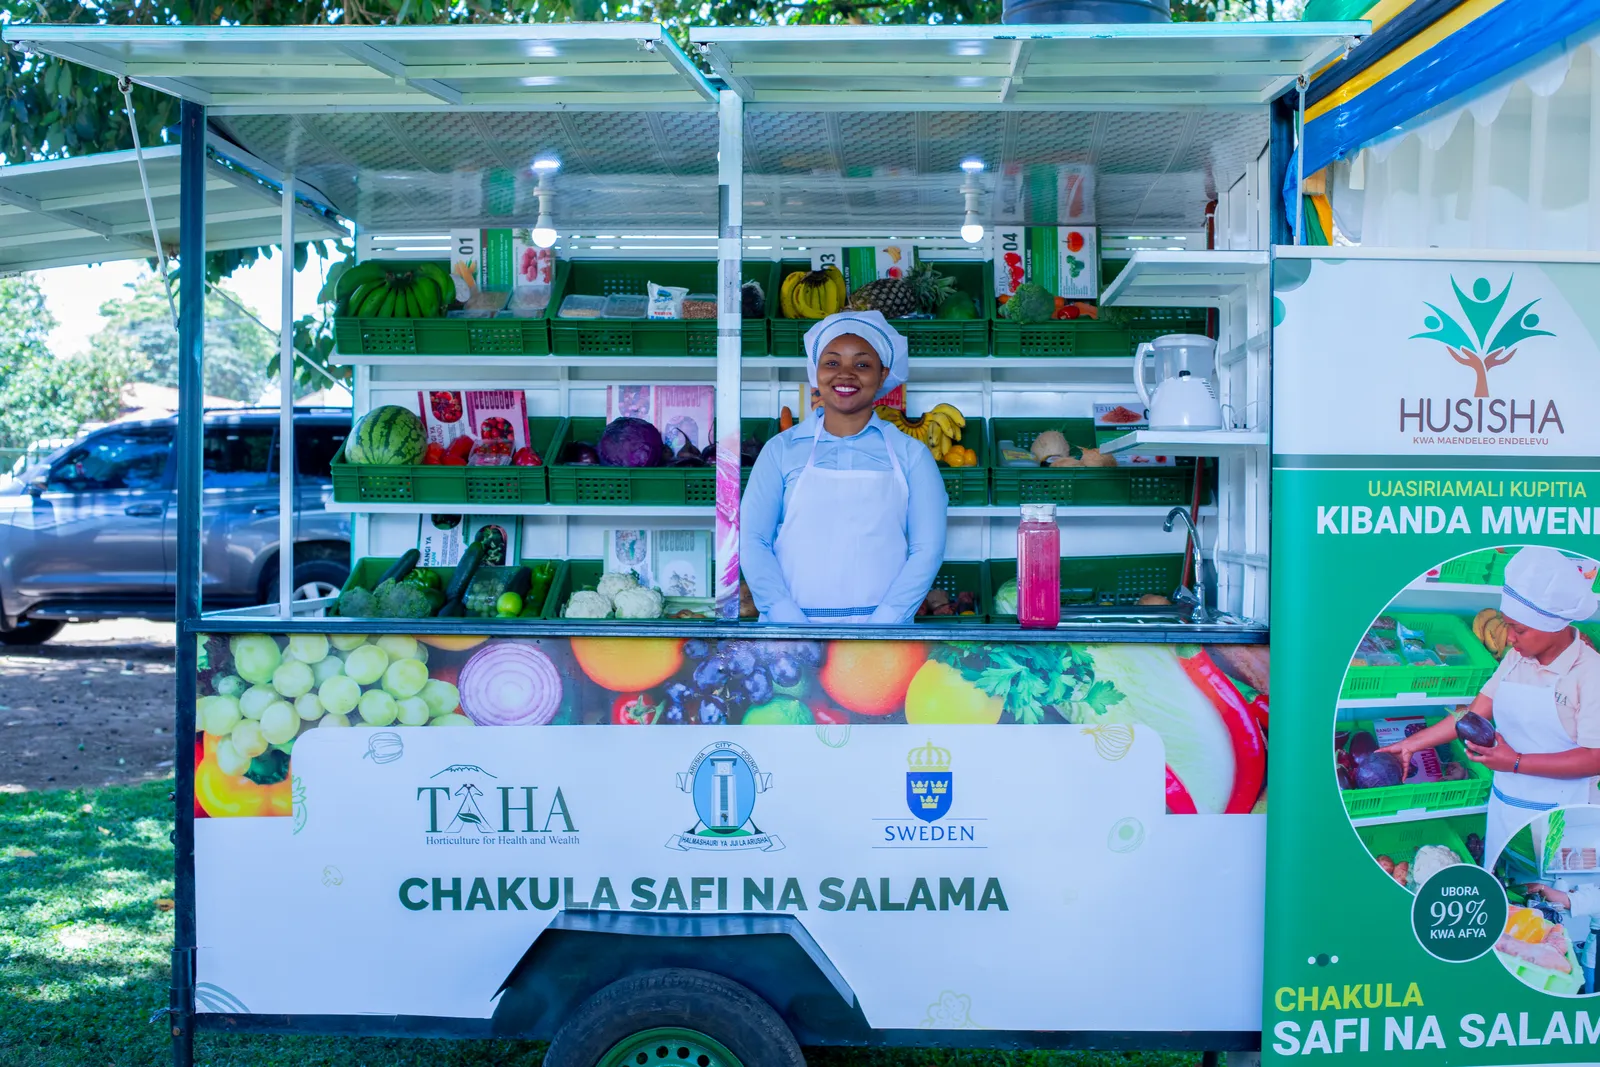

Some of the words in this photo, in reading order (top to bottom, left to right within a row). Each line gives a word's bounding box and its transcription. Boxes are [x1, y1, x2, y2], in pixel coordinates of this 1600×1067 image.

[458, 238, 474, 255] 01
[1002, 232, 1018, 251] 04
[1400, 398, 1565, 434] HUSISHA
[1412, 436, 1435, 445] KWA
[1437, 436, 1496, 446] MAENDELEO
[1498, 437, 1549, 446] ENDELEVU
[1368, 480, 1503, 497] UJASIRIAMALI
[1510, 481, 1587, 498] KUPITIA
[1316, 505, 1471, 535] KIBANDA
[689, 752, 706, 776] ARUSHA
[426, 836, 480, 845] Horticulture
[482, 836, 496, 845] for
[499, 836, 528, 845] Health
[530, 836, 546, 845] and
[549, 836, 580, 845] Wealth
[884, 825, 975, 842] SWEDEN
[398, 877, 620, 911] CHAKULA
[630, 877, 728, 911] SAFI
[743, 877, 808, 911] NA
[818, 877, 1009, 912] SALAMA
[1441, 886, 1480, 897] UBORA
[1430, 899, 1488, 927] 99%
[1430, 929, 1456, 939] KWA
[1458, 928, 1487, 938] AFYA
[1274, 982, 1424, 1012] CHAKULA
[1272, 1017, 1370, 1056] SAFI
[1384, 1015, 1447, 1051] NA
[1458, 1011, 1600, 1048] SALAM
